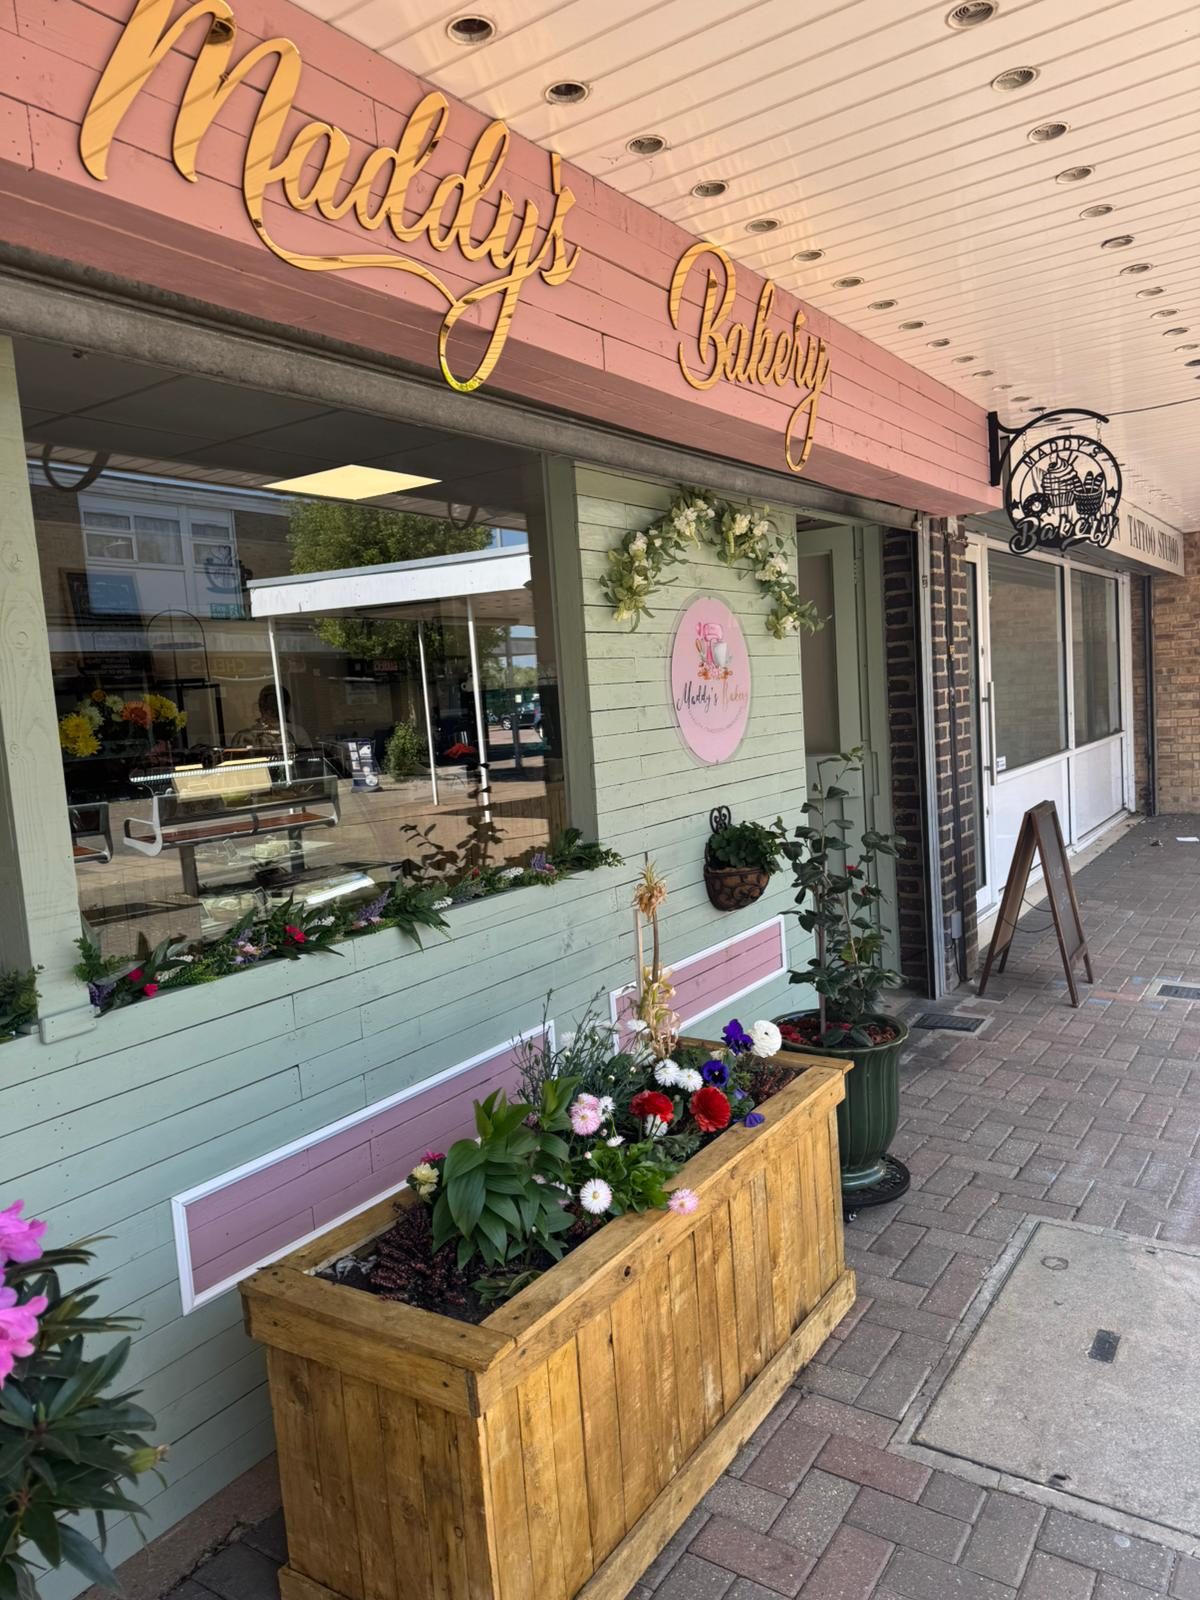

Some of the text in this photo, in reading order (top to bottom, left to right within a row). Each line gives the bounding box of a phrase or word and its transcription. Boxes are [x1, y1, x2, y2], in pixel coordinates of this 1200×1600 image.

[79, 0, 832, 472] Maddy's Bakery
[1009, 513, 1119, 554] Bakery
[1127, 514, 1156, 556] TATTOO
